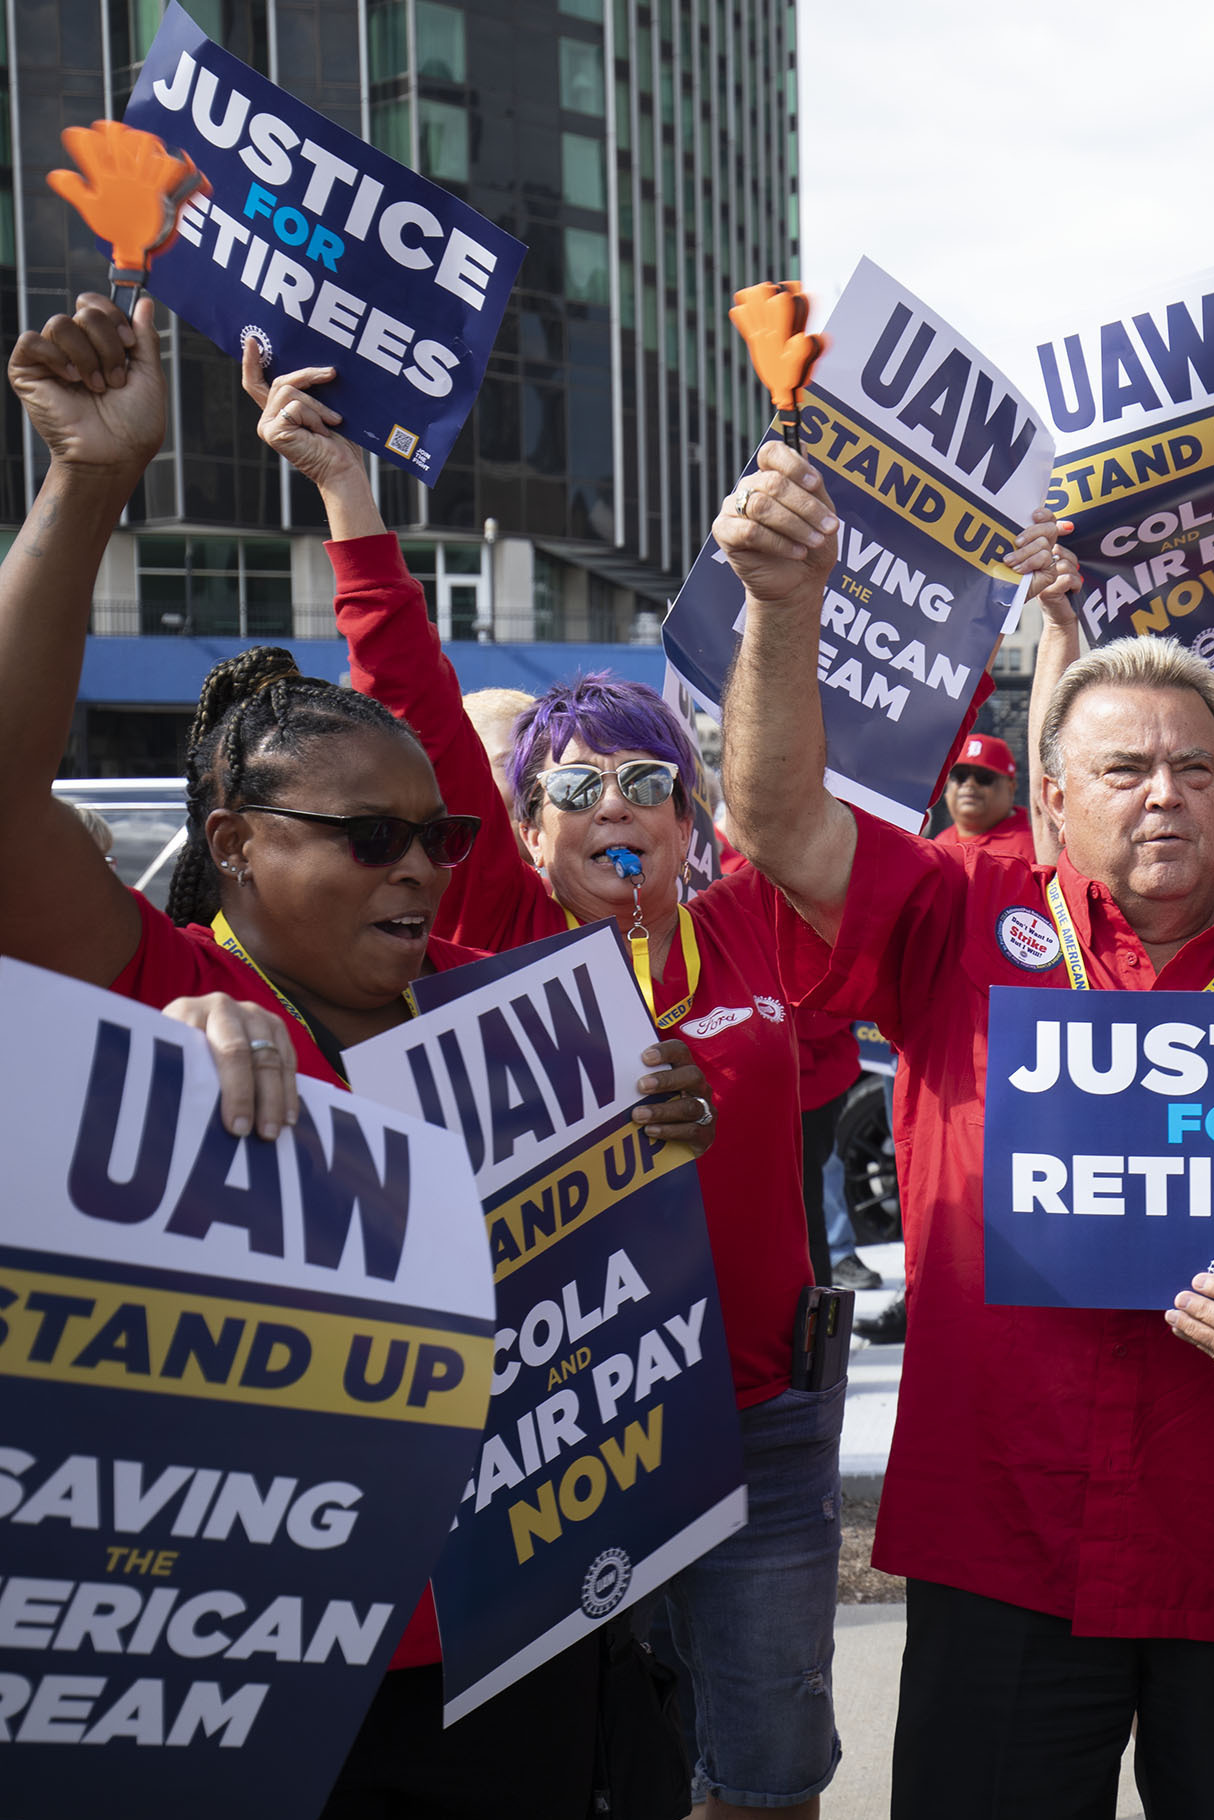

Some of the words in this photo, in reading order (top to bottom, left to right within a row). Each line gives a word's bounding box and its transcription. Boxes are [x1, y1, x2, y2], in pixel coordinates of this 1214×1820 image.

[153, 50, 498, 311] JUSTICE
[243, 182, 345, 273] FOR
[176, 191, 460, 398] ETIREES
[861, 302, 1037, 495] UAW
[800, 405, 946, 524] STAND
[953, 512, 1015, 566] UP
[1045, 435, 1203, 513] STAND
[836, 519, 954, 622] VING
[1160, 531, 1200, 553] AND
[840, 574, 873, 603] THE
[1082, 549, 1189, 641] FAIR
[817, 639, 910, 722] EAM
[687, 828, 712, 882] LA
[1010, 926, 1047, 953] Strike
[1010, 937, 1021, 948] But
[1011, 916, 1028, 930] Don't
[1029, 928, 1045, 940] Want
[1031, 919, 1037, 929] I
[1054, 902, 1069, 926] THE
[1062, 928, 1087, 990] AMERICAN
[657, 1004, 688, 1029] NITED
[697, 1010, 737, 1034] Ford
[406, 962, 616, 1177] UAW
[67, 1017, 411, 1283] UAW
[492, 1170, 589, 1275] AND
[603, 1129, 666, 1192] UP
[490, 1248, 651, 1396] COLA
[342, 1334, 466, 1408] UP
[547, 1347, 592, 1392] AND
[450, 1389, 588, 1532] AIR
[591, 1297, 708, 1425] PAY
[508, 1403, 664, 1565] NOW
[105, 1546, 180, 1577] THE
[0, 1576, 395, 1666] ERICAN
